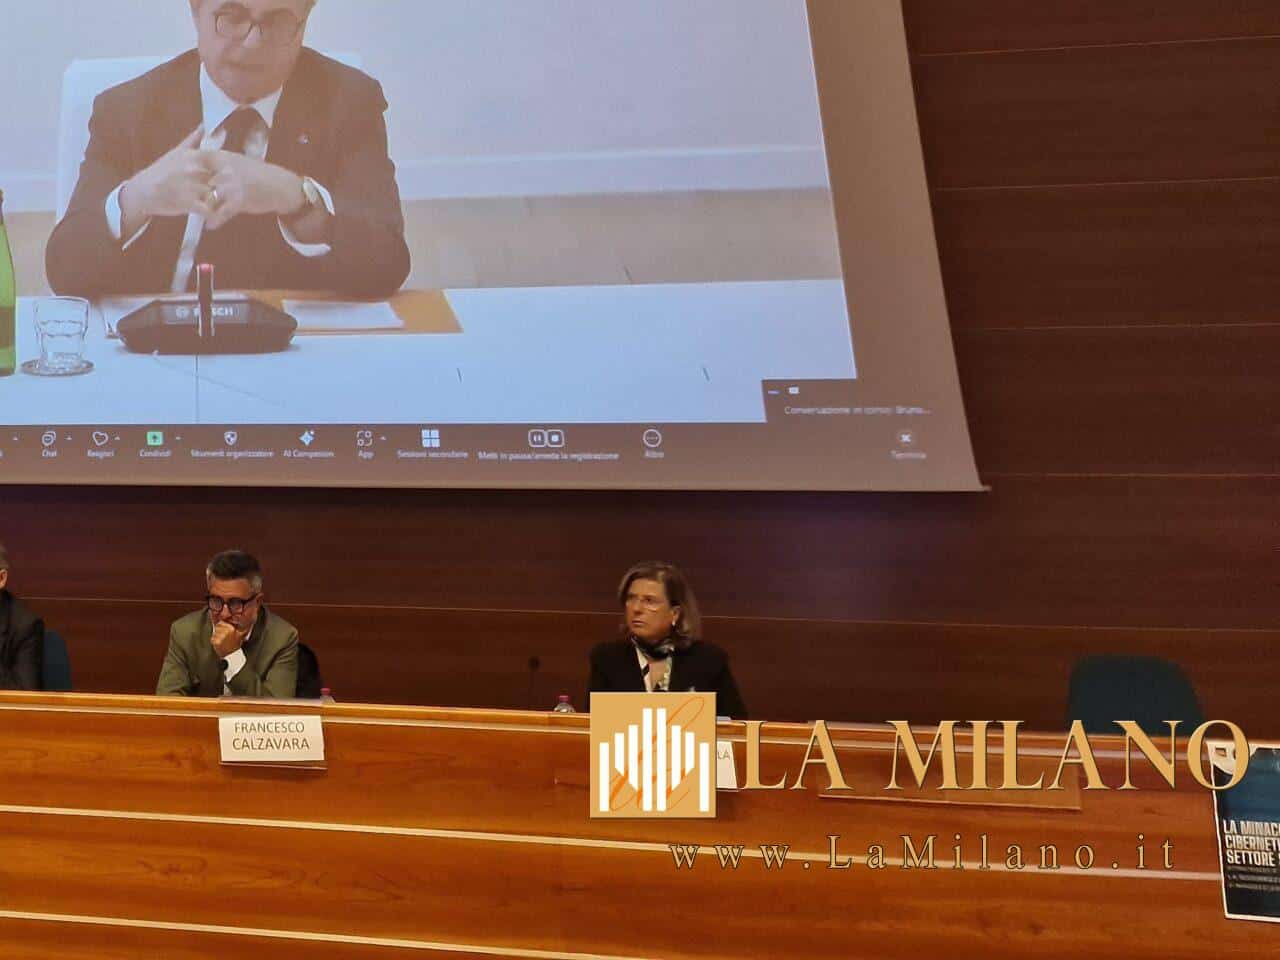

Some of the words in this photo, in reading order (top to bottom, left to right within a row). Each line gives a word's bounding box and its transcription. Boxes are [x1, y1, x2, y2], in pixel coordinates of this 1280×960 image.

[234, 721, 305, 733] FRANCESCO
[232, 738, 310, 750] CALZAVARA
[1223, 819, 1238, 835] LA
[1240, 820, 1280, 836] MINAC
[1227, 849, 1276, 867] SETTORE
